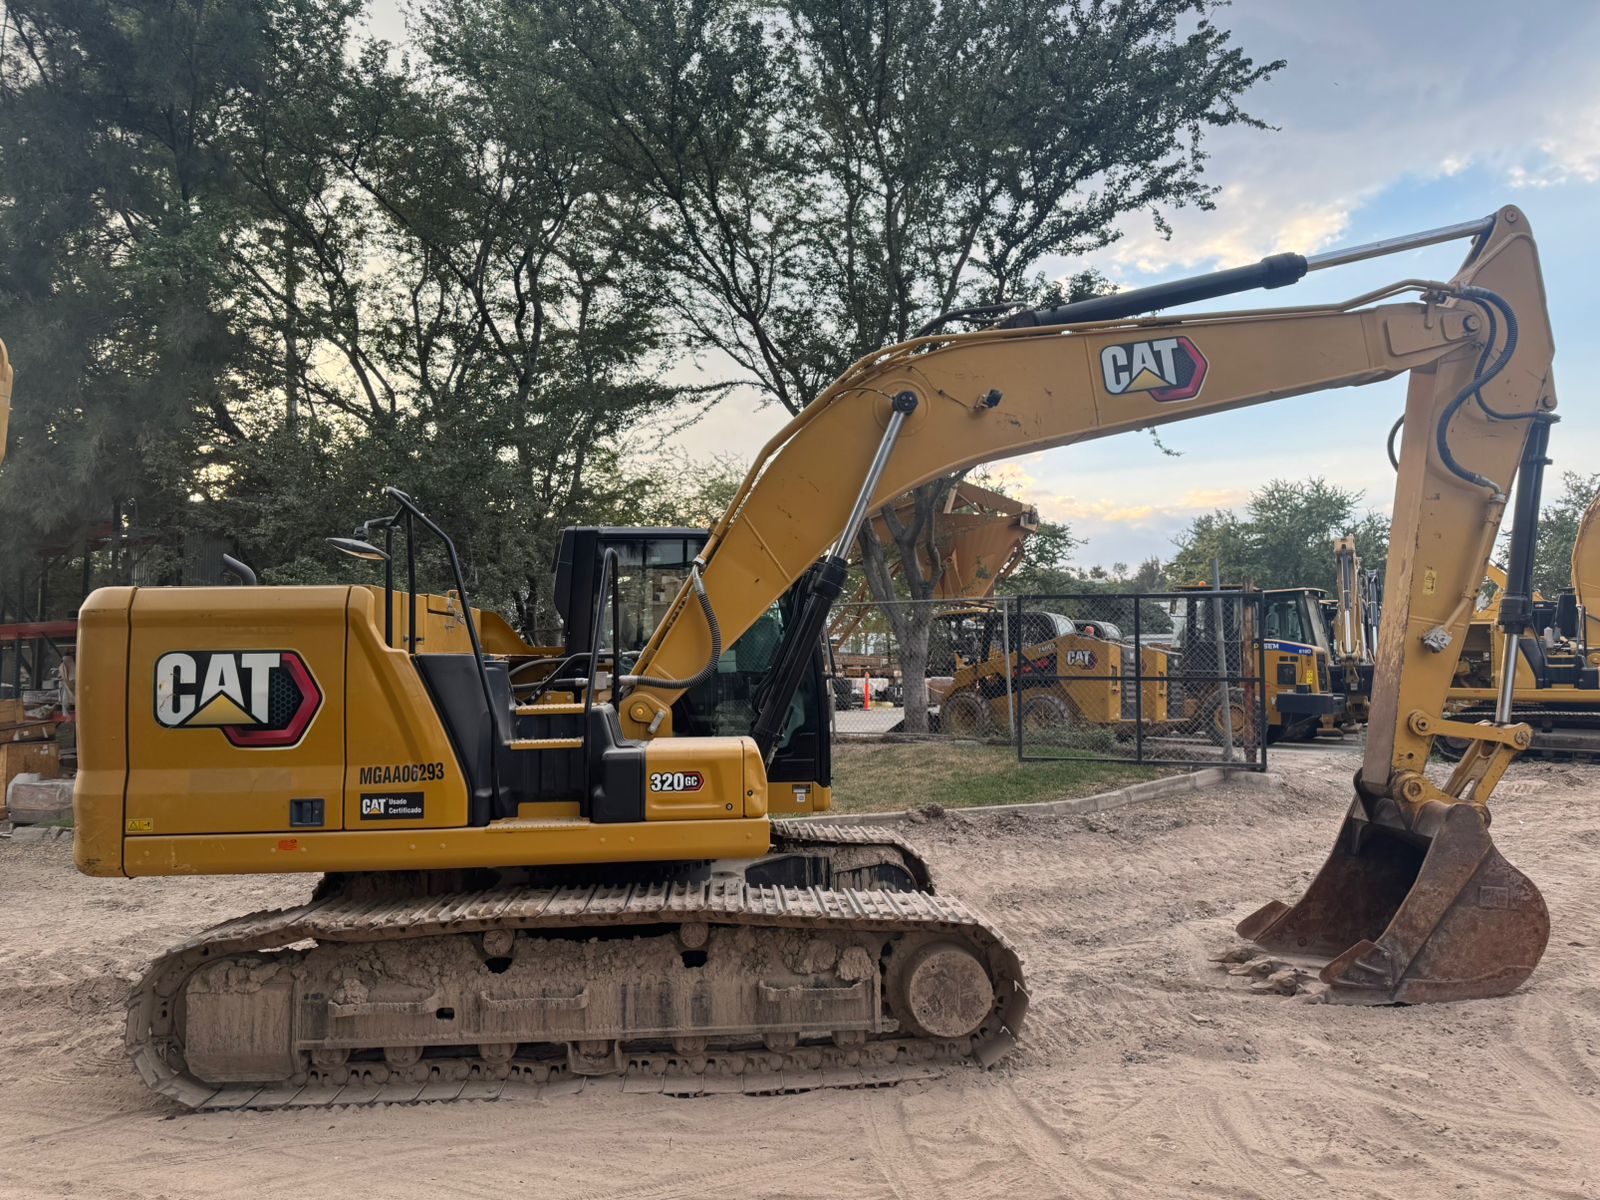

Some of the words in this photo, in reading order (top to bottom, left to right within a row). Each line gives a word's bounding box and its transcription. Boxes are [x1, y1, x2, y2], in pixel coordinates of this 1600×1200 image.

[1101, 338, 1178, 394] CAT
[1067, 650, 1090, 666] CAT
[157, 653, 280, 725] CAT
[360, 762, 444, 785] MGAA06293
[651, 773, 684, 791] 320
[685, 777, 697, 786] GC
[362, 799, 386, 814] CAT
